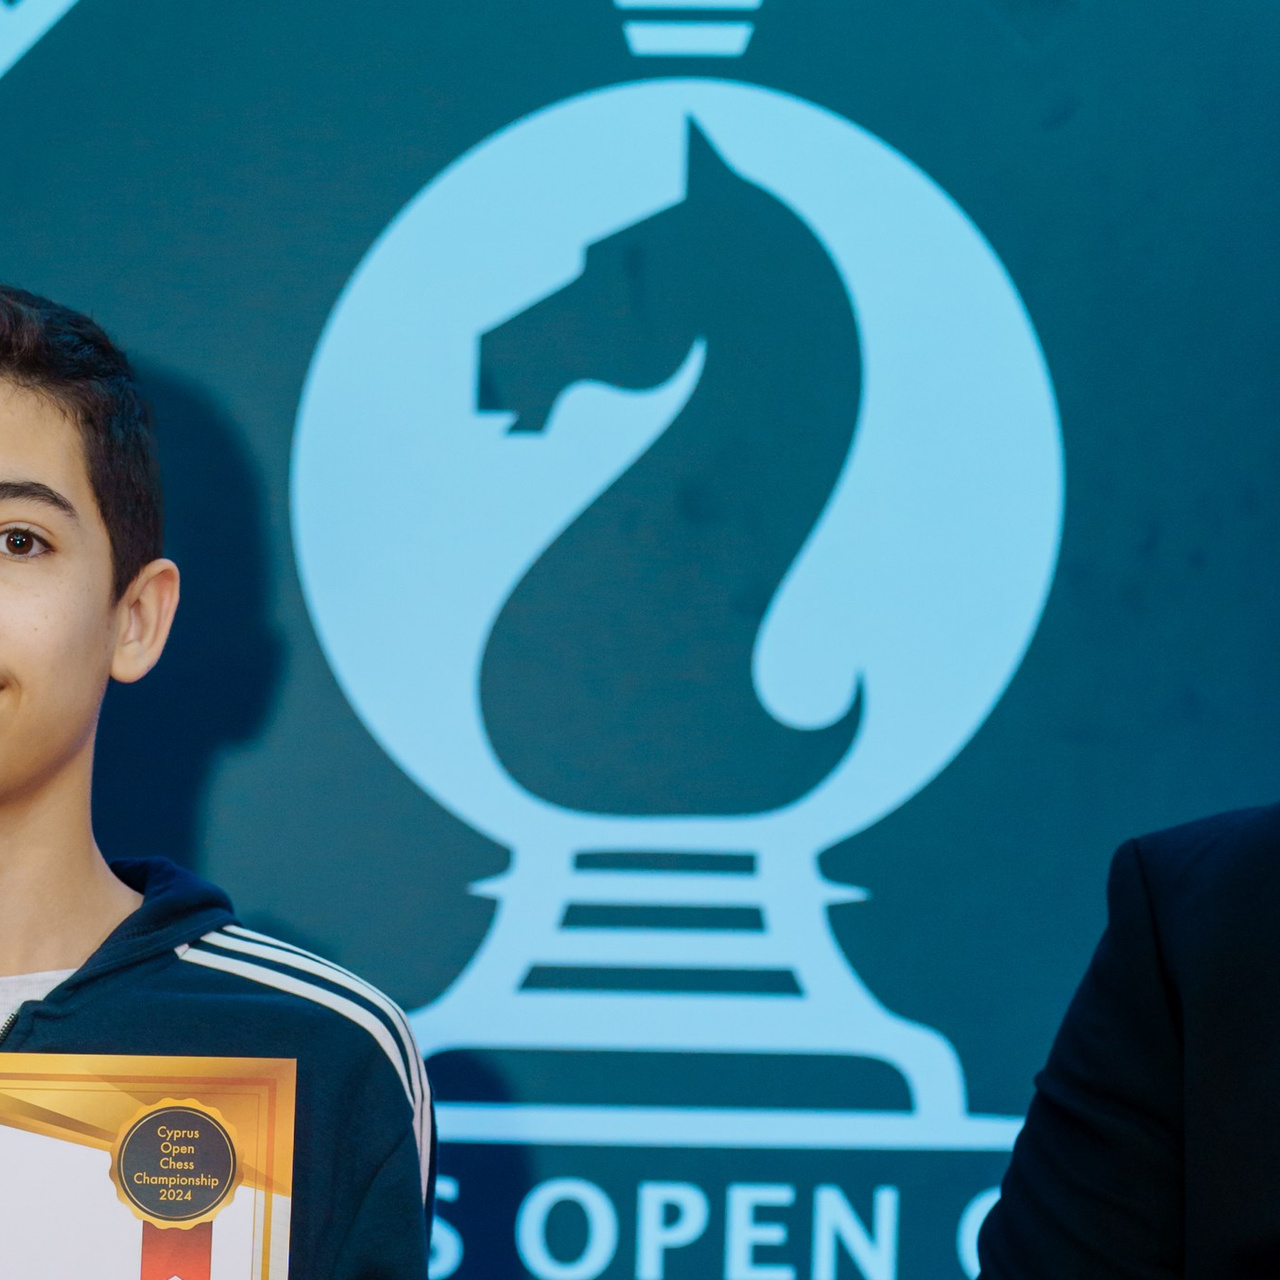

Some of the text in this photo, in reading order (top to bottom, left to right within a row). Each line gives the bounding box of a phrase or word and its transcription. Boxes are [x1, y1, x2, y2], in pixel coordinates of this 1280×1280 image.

[157, 1125, 200, 1141] Cyprus
[160, 1142, 195, 1157] Open
[160, 1157, 195, 1170] Chess
[133, 1171, 219, 1189] Championship
[159, 1189, 192, 1201] 2024
